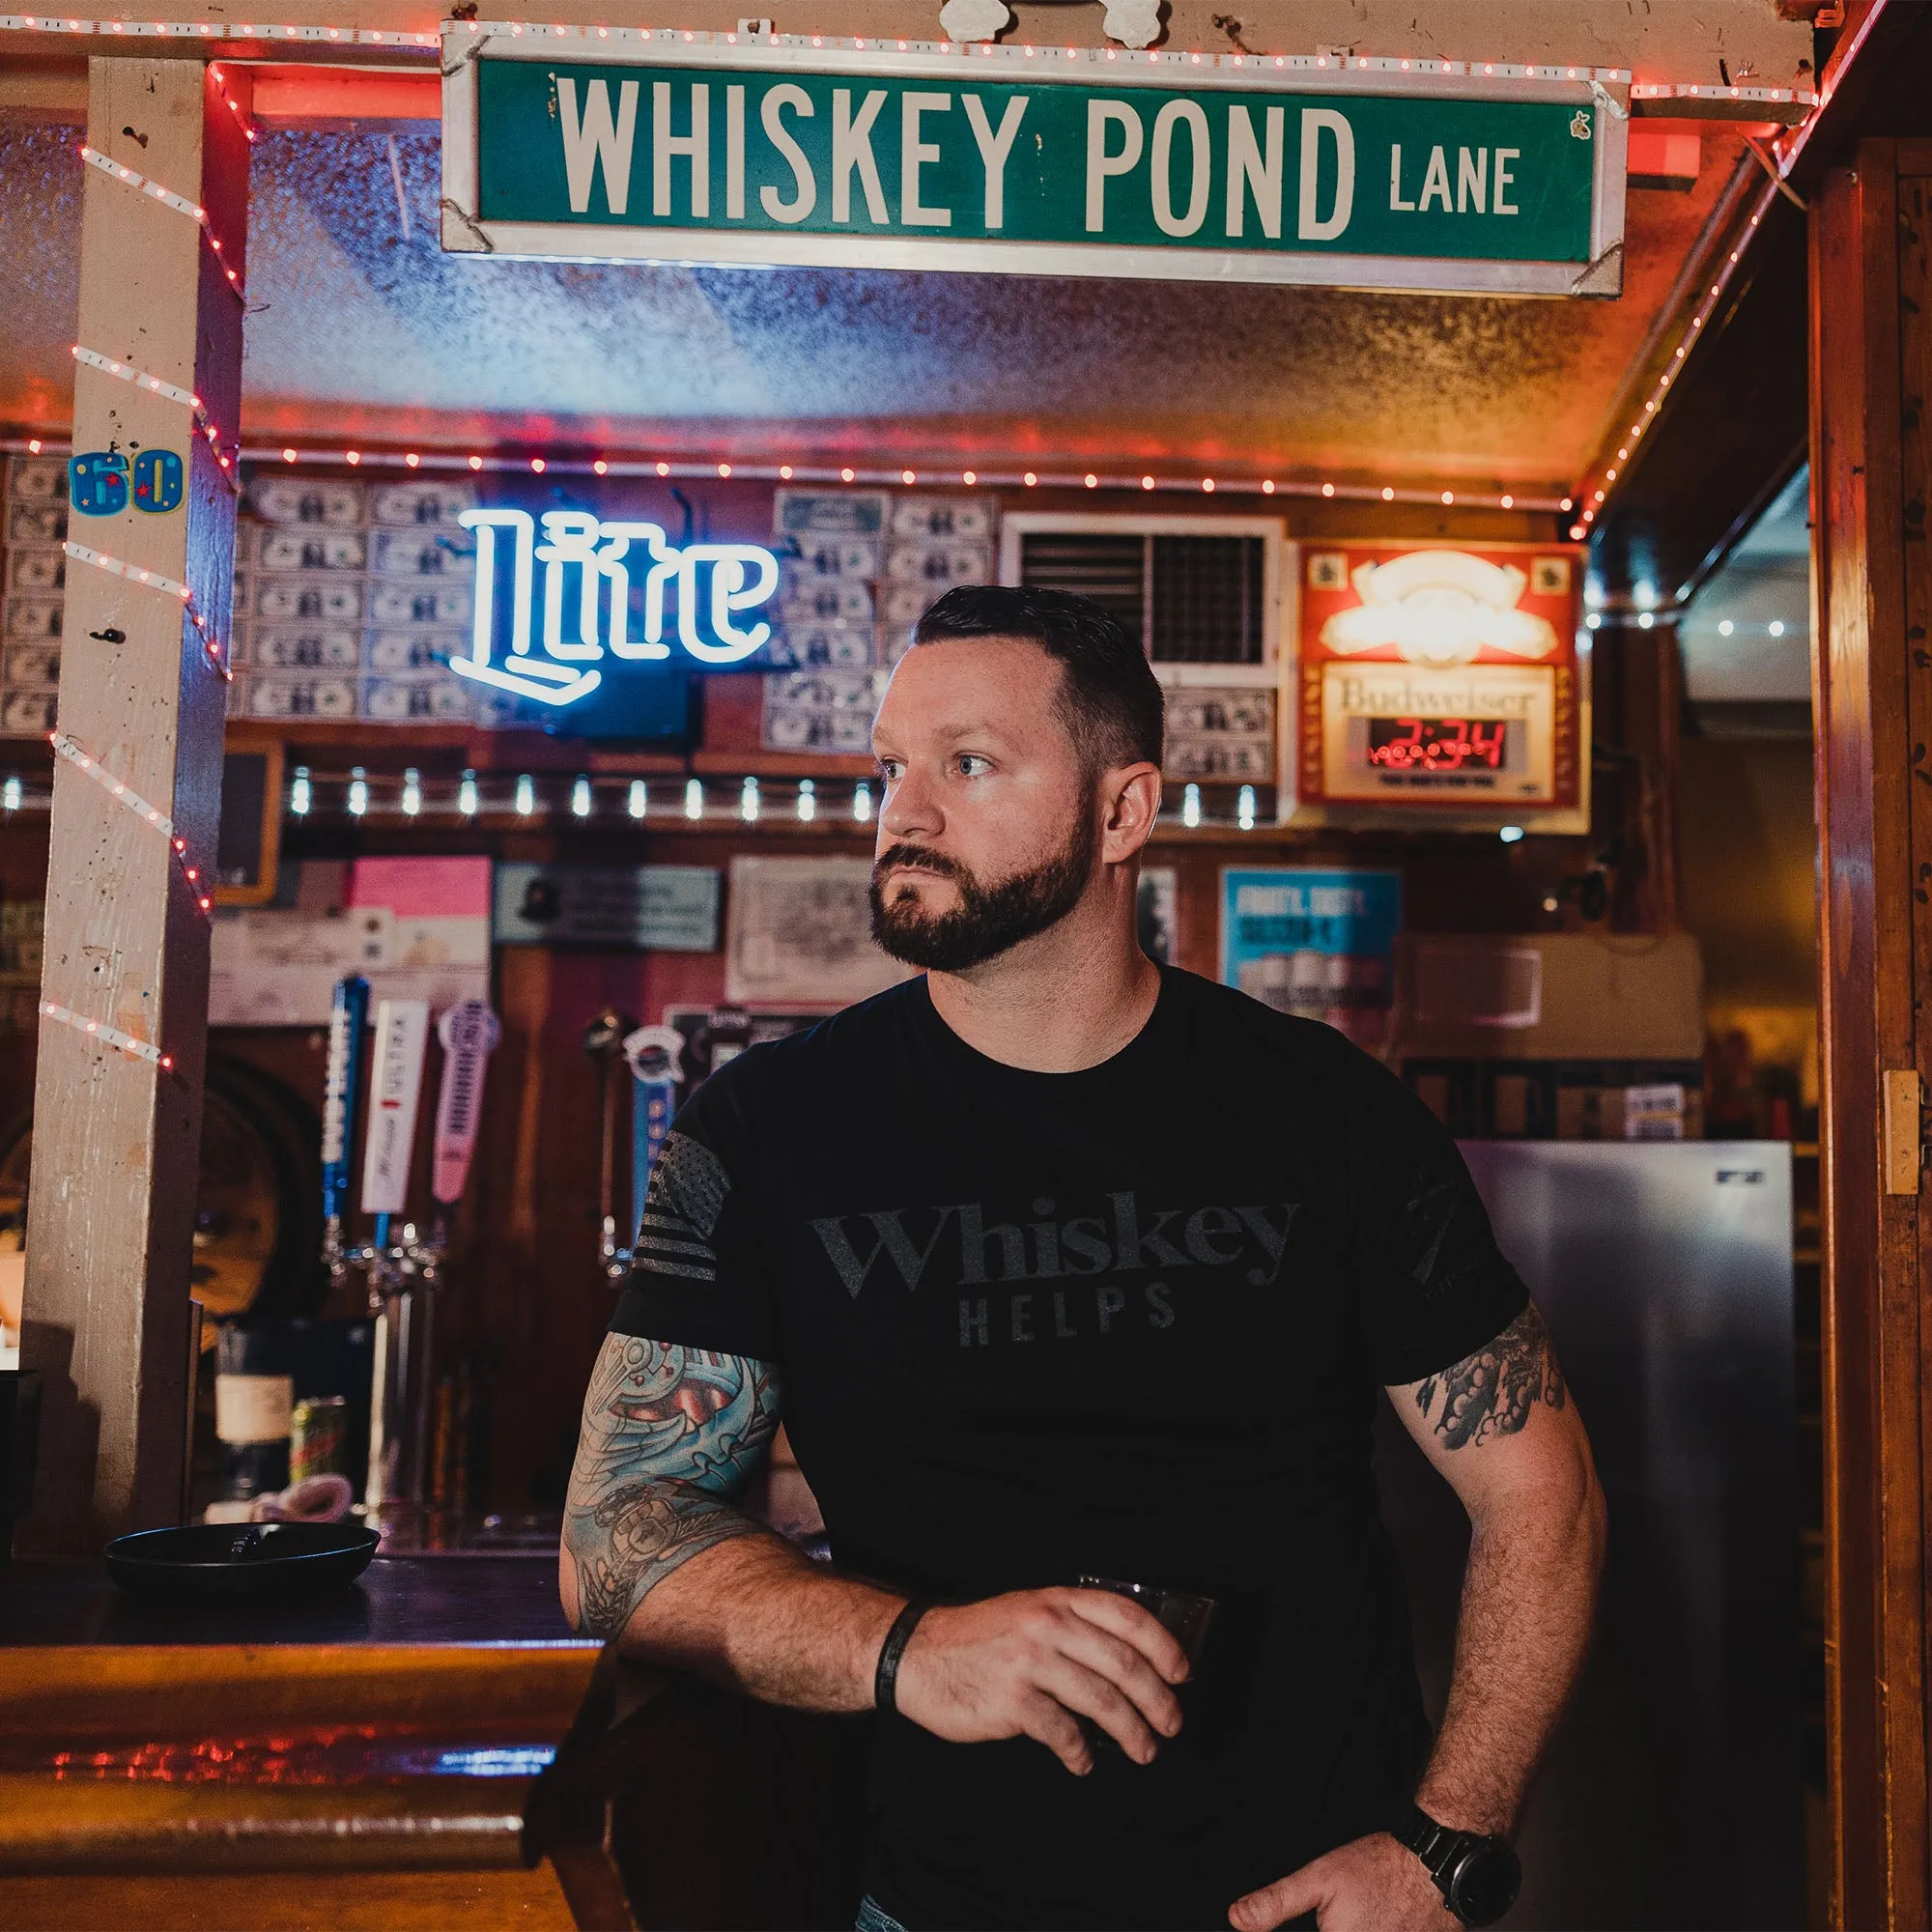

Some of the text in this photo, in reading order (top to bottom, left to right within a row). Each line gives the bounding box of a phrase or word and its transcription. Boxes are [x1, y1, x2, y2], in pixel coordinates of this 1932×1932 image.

[557, 77, 1520, 241] WHISKEY POND LANE
[68, 449, 184, 517] 60
[449, 509, 779, 706] Lite
[1340, 678, 1538, 715] Budweiser
[806, 1190, 1302, 1300] Whiskey
[958, 1282, 1176, 1348] HELPS
